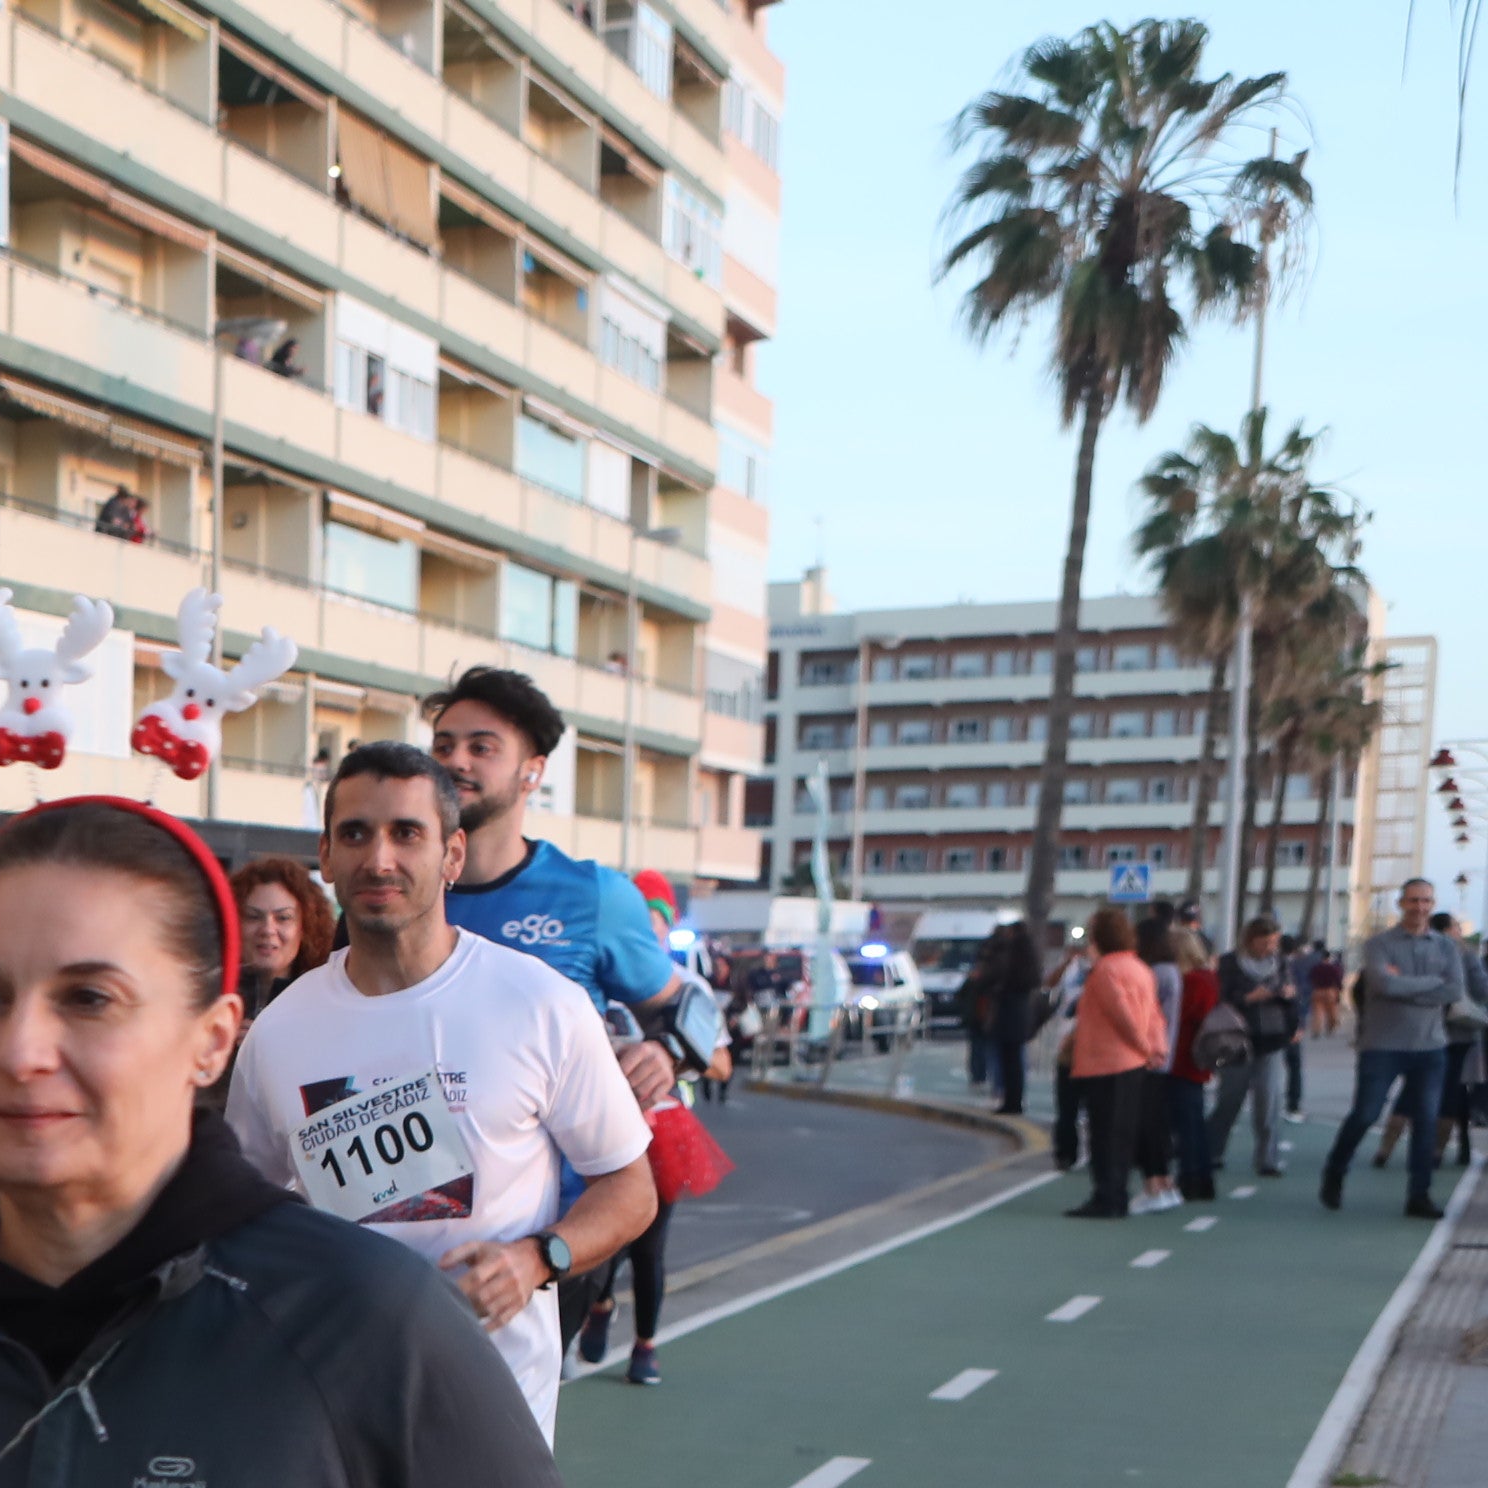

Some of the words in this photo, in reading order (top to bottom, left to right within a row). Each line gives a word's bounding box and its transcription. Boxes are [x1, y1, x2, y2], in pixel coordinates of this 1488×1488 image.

[501, 914, 564, 945] ego
[298, 1119, 330, 1141] SAN
[332, 1077, 426, 1122] SILVESTRE
[301, 1119, 357, 1152] CIUDAD
[361, 1109, 380, 1126] DE
[321, 1111, 434, 1188] 1100
